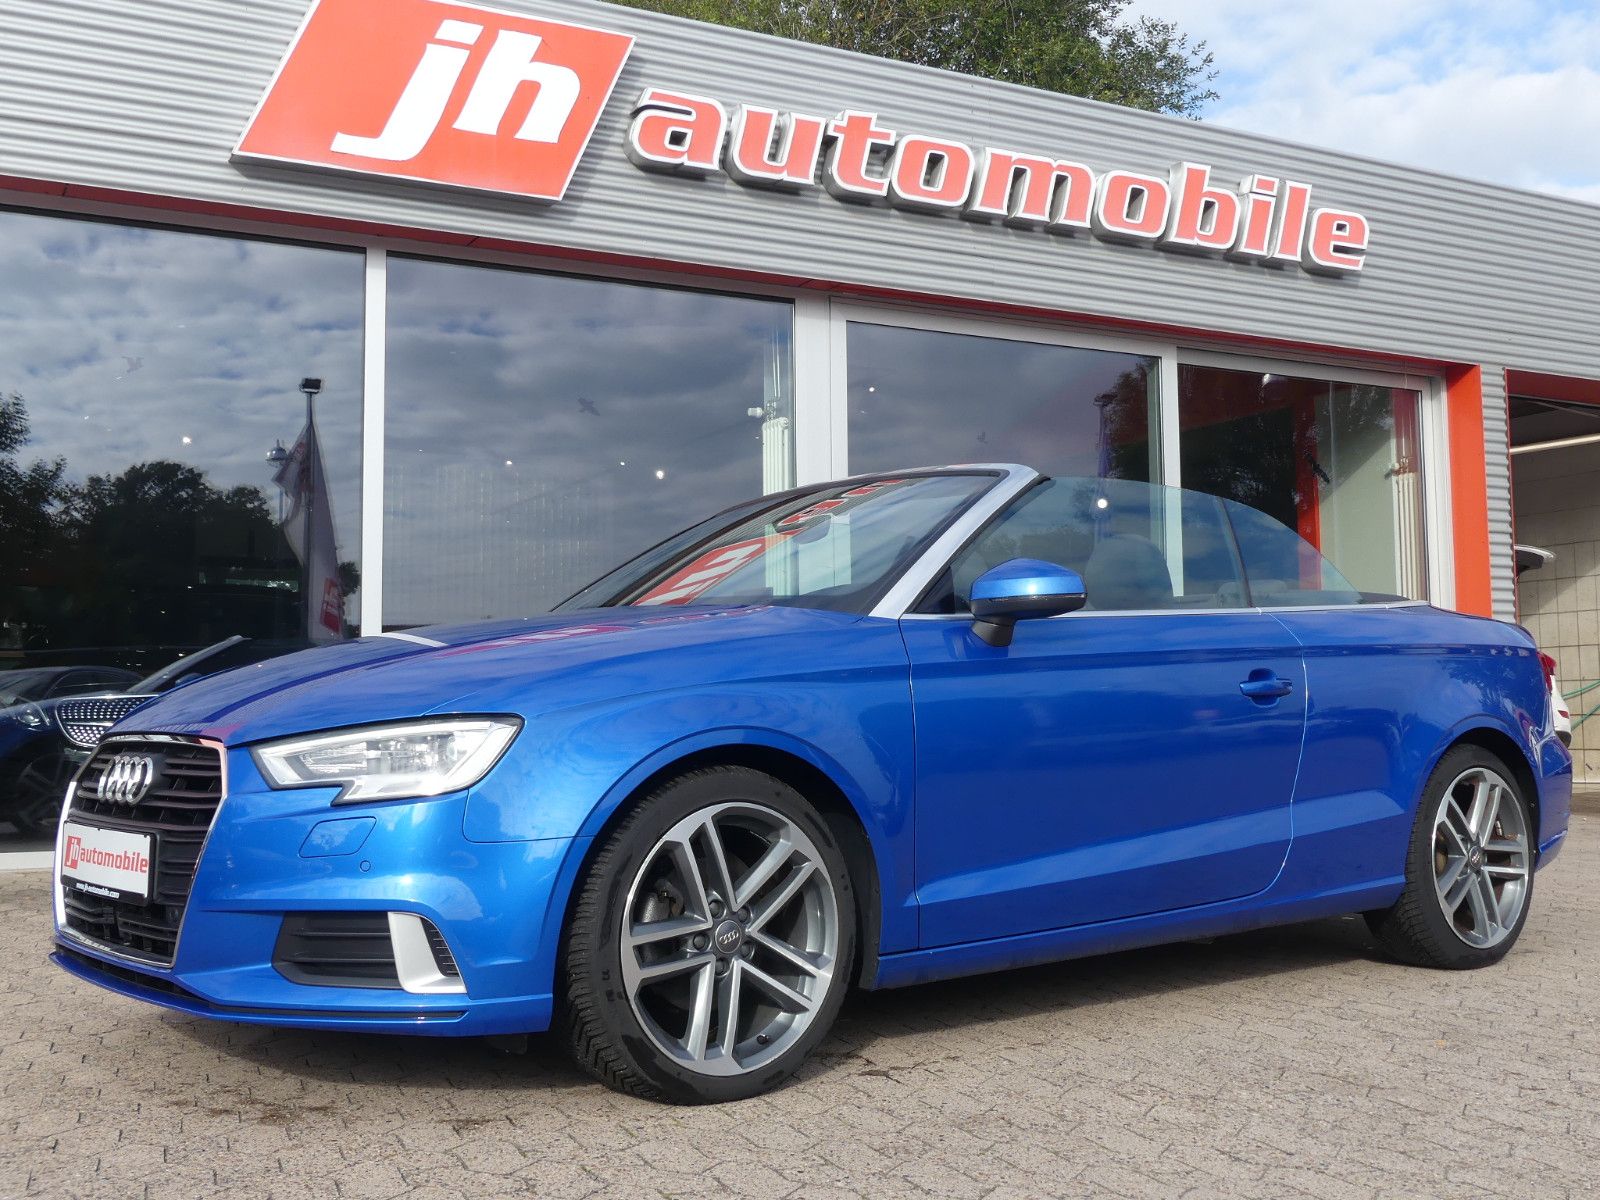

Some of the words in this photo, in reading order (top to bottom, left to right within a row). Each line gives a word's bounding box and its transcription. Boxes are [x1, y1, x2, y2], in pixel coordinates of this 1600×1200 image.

[330, 19, 581, 161] jh
[626, 86, 1370, 272] automobile
[80, 847, 148, 874] automobile
